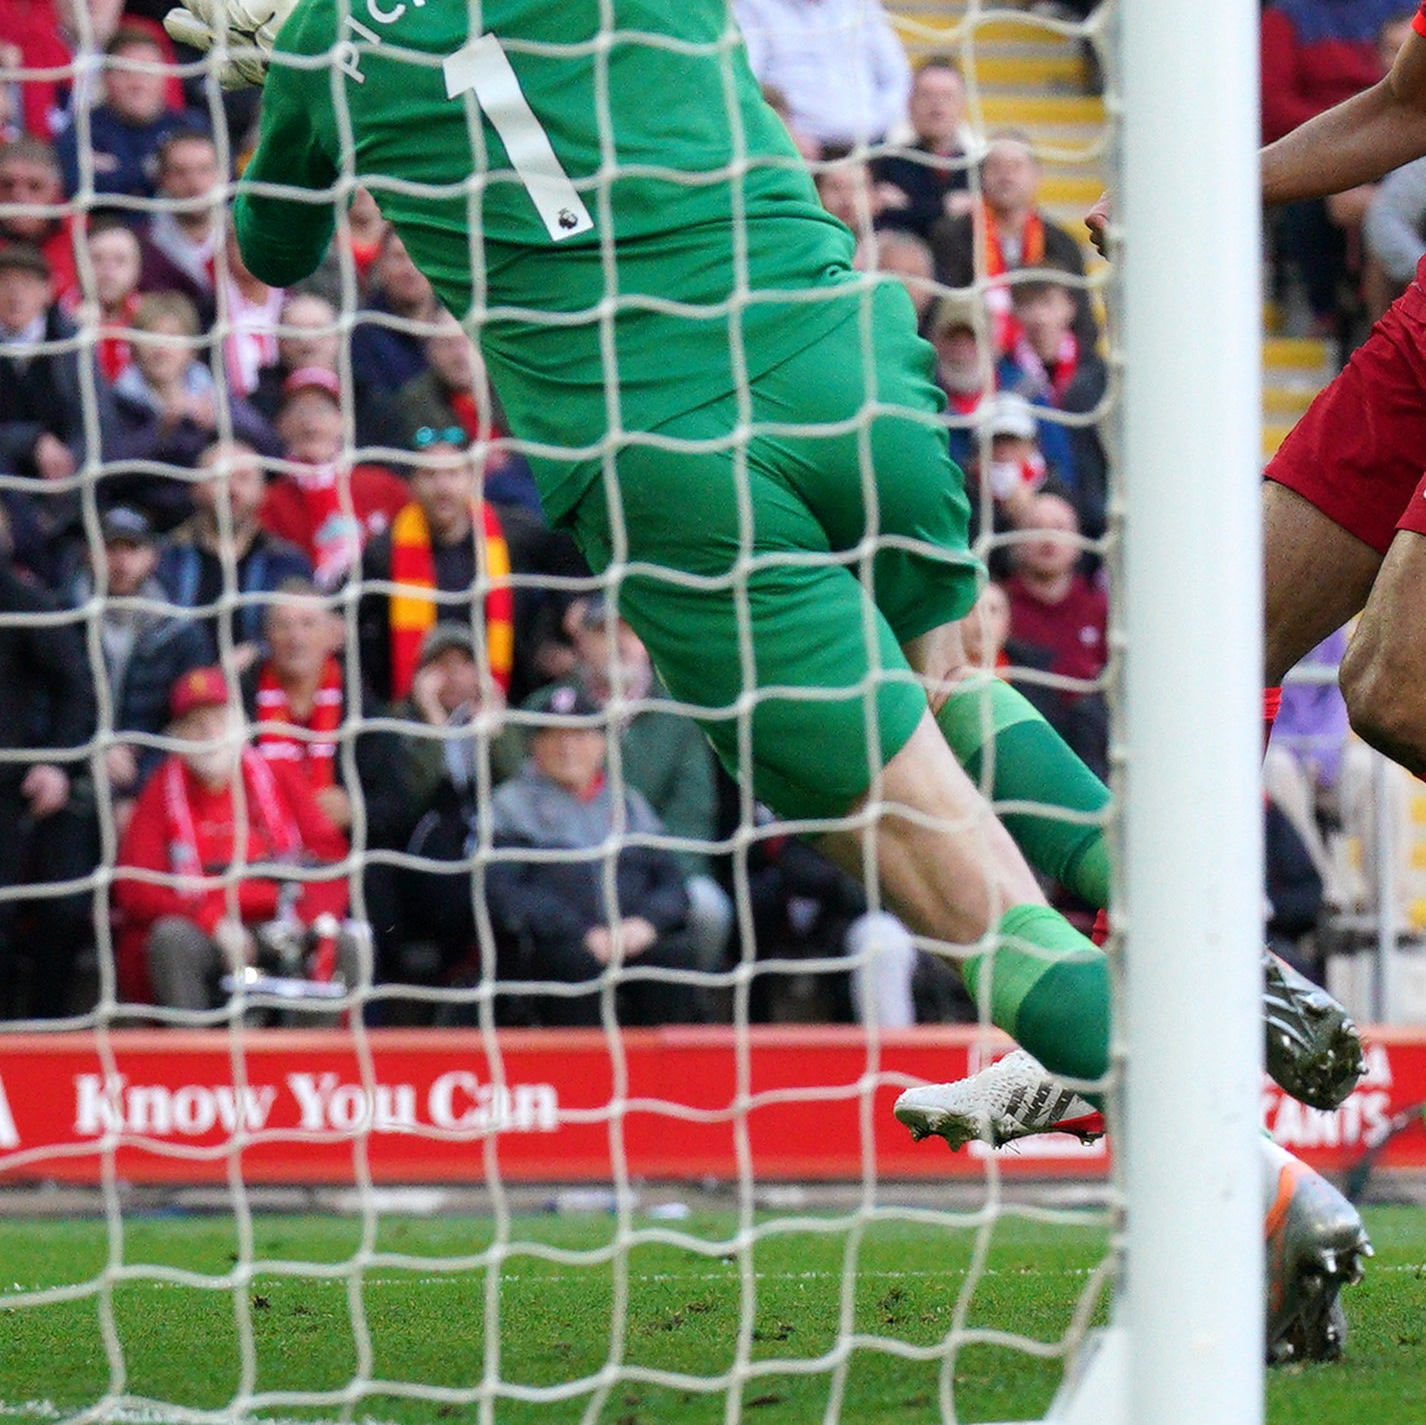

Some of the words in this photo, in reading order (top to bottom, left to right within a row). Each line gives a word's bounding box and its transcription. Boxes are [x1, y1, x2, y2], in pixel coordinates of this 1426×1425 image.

[442, 32, 594, 242] 1
[75, 1073, 275, 1135] Know
[288, 1072, 414, 1133] You
[428, 1070, 560, 1133] Can
